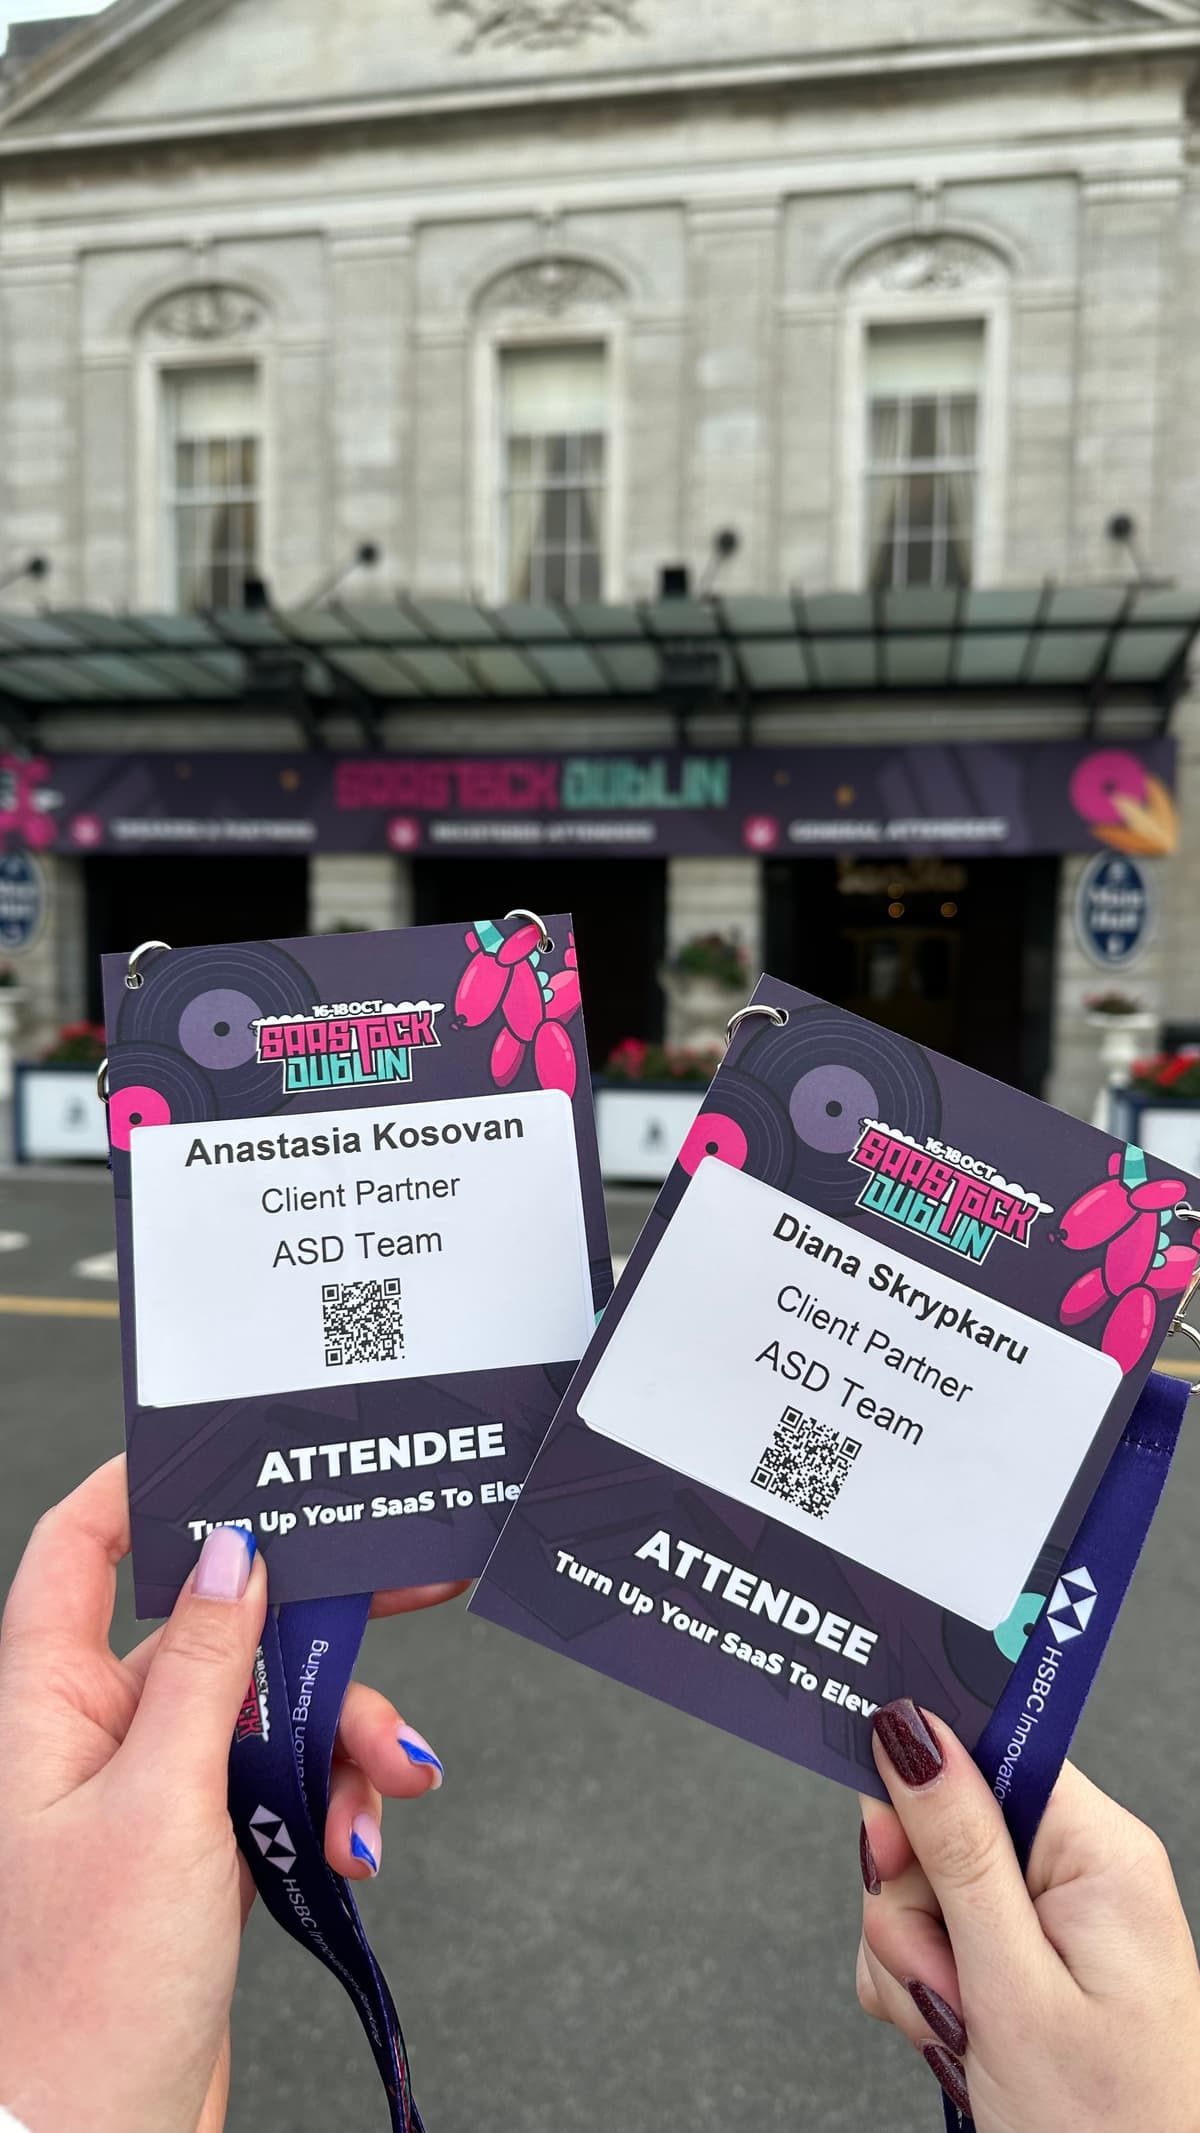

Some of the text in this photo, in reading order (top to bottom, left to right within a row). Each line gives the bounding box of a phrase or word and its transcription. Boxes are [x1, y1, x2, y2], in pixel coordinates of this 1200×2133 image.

[185, 1117, 524, 1167] Anastasia Kosovan
[261, 1177, 461, 1214] Client Partner
[272, 1231, 442, 1268] ASD Team
[772, 1212, 1030, 1364] Diana Skrypkaru
[777, 1285, 973, 1403] Client Partner
[755, 1340, 924, 1445] ASD Team
[256, 1423, 506, 1487] ATTENDEE
[260, 1511, 297, 1535] Up
[303, 1504, 364, 1527] Your
[371, 1491, 435, 1518] SaaS
[441, 1488, 475, 1509] To
[554, 1551, 614, 1594] Turn
[618, 1582, 654, 1615] Up
[659, 1600, 719, 1643] Your
[720, 1632, 785, 1676] SaaS
[788, 1661, 819, 1691] To
[634, 1530, 878, 1665] ATTENDEE
[292, 1639, 329, 1722] Banking
[1025, 1645, 1063, 1713] HSBC
[282, 1878, 317, 1930] HSBC
